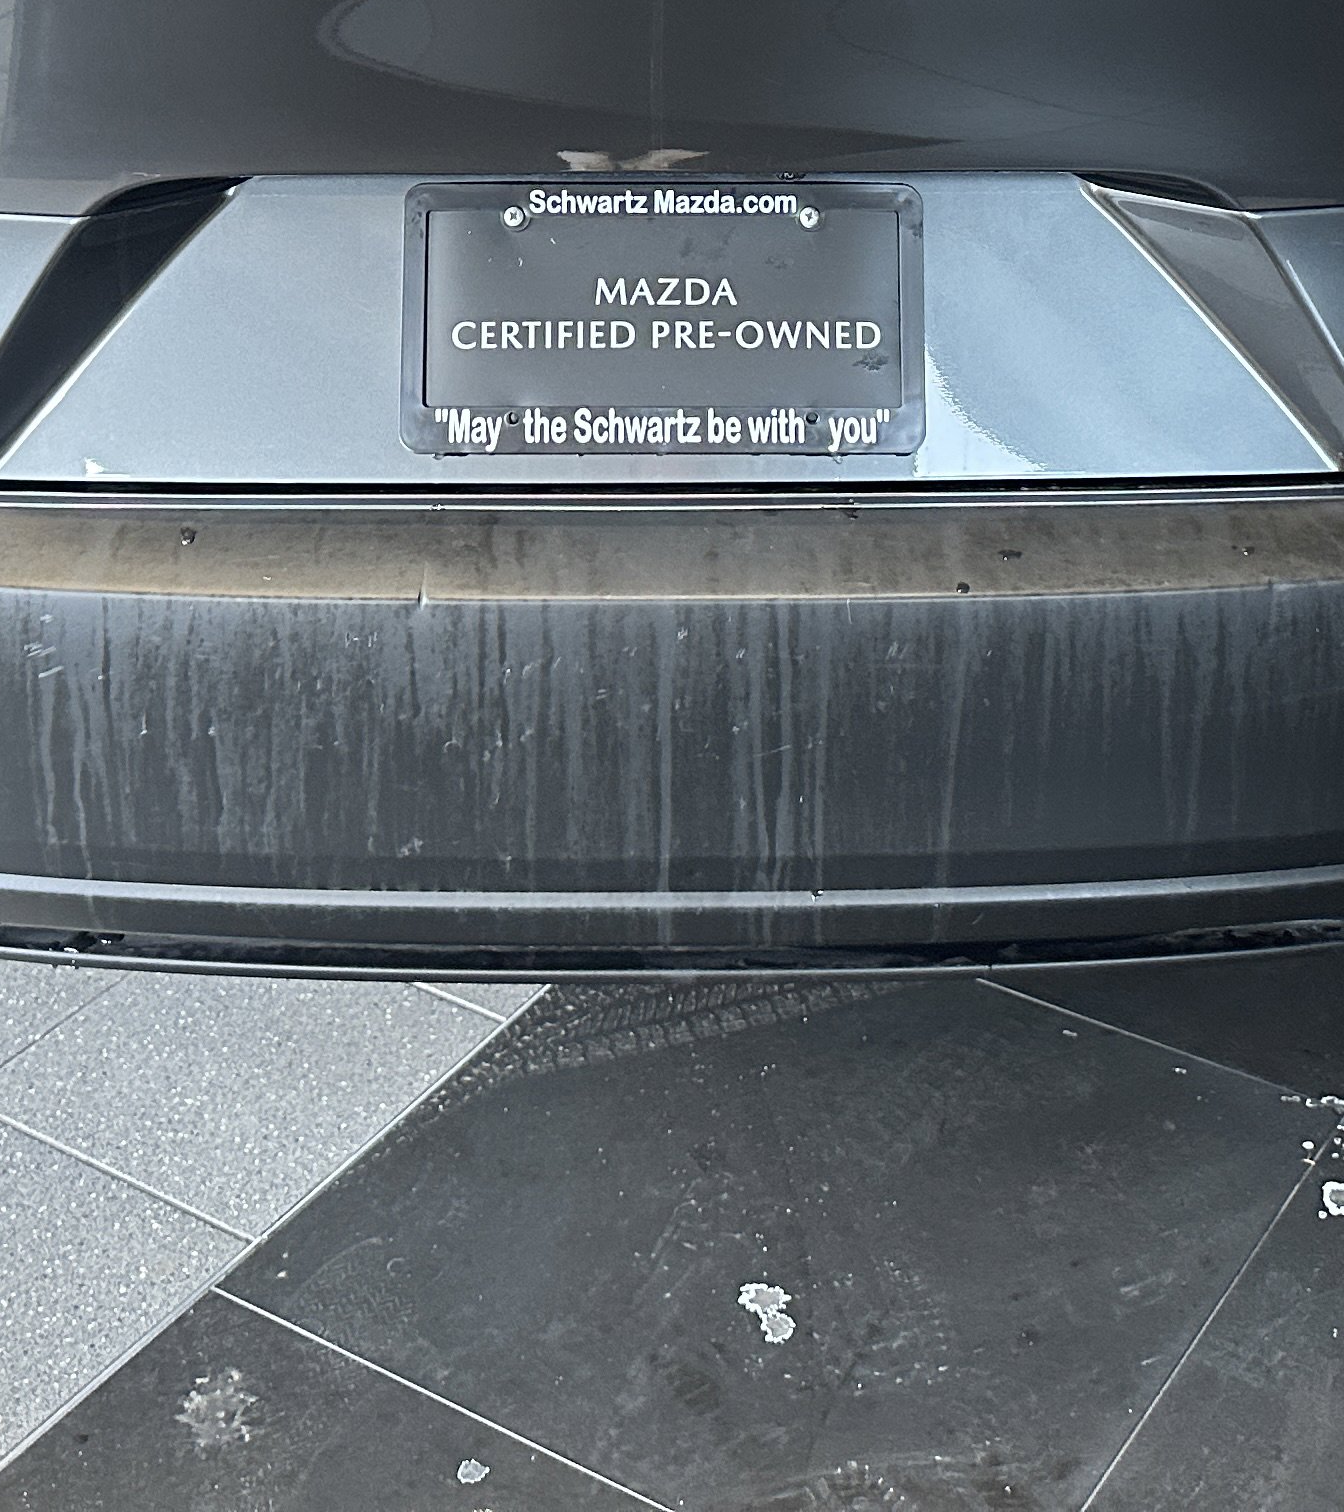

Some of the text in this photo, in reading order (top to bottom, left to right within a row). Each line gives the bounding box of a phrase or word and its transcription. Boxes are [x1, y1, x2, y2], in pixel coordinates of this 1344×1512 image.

[528, 188, 798, 215] Schwartz Mazda.com
[594, 277, 739, 307] MAZDA
[451, 320, 882, 351] CERTIFIED PRE-OWNED
[435, 408, 891, 452] "May the Schwartz be with you"
